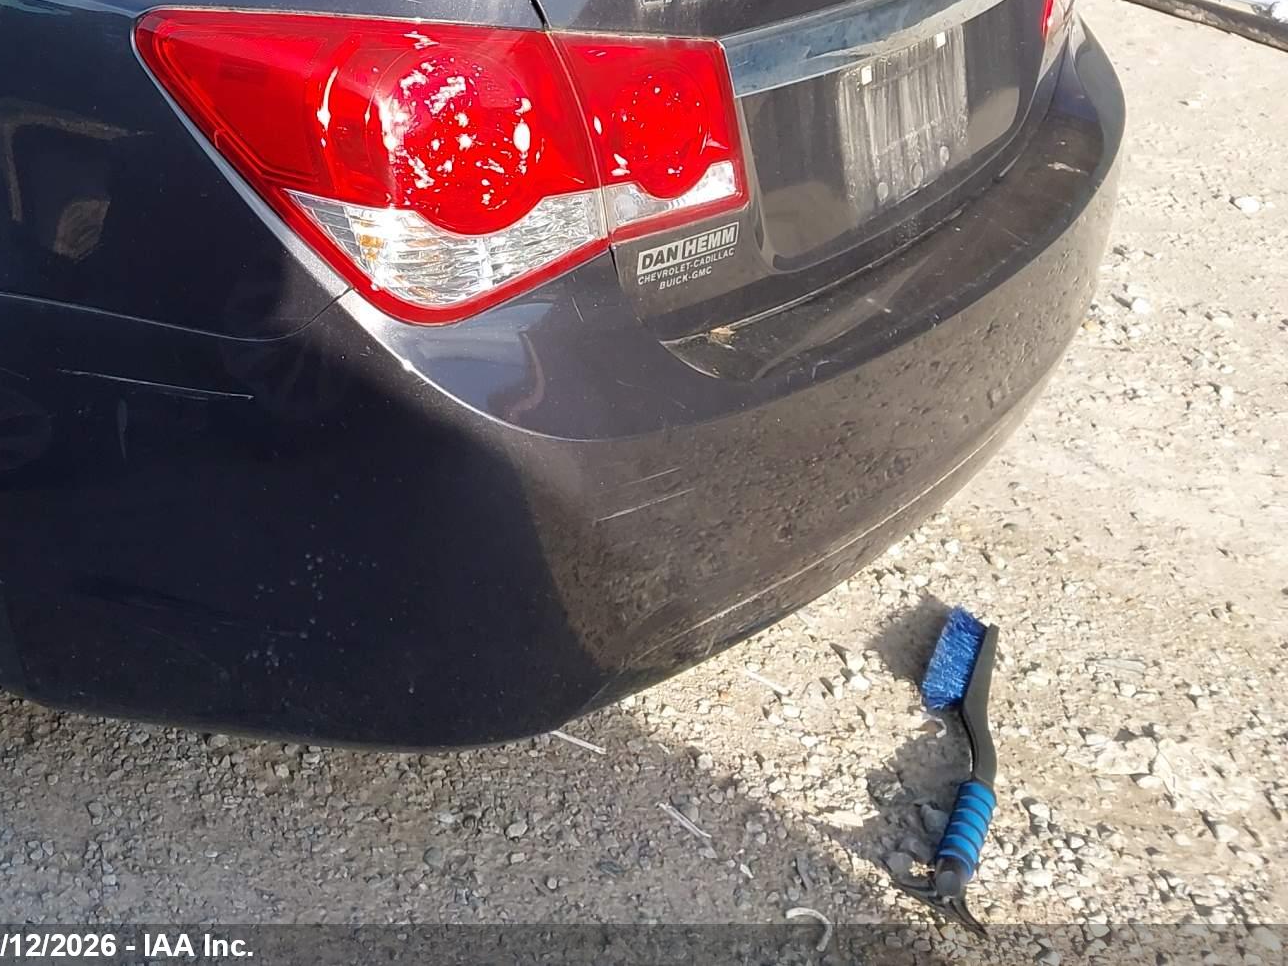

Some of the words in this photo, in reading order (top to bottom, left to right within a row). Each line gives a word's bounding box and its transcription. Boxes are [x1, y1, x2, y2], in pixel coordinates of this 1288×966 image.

[638, 247, 735, 285] CHEVROLET-CADILLAC
[642, 245, 679, 270] DAN
[684, 226, 736, 257] HEMM
[659, 266, 712, 290] BUICK-GMC
